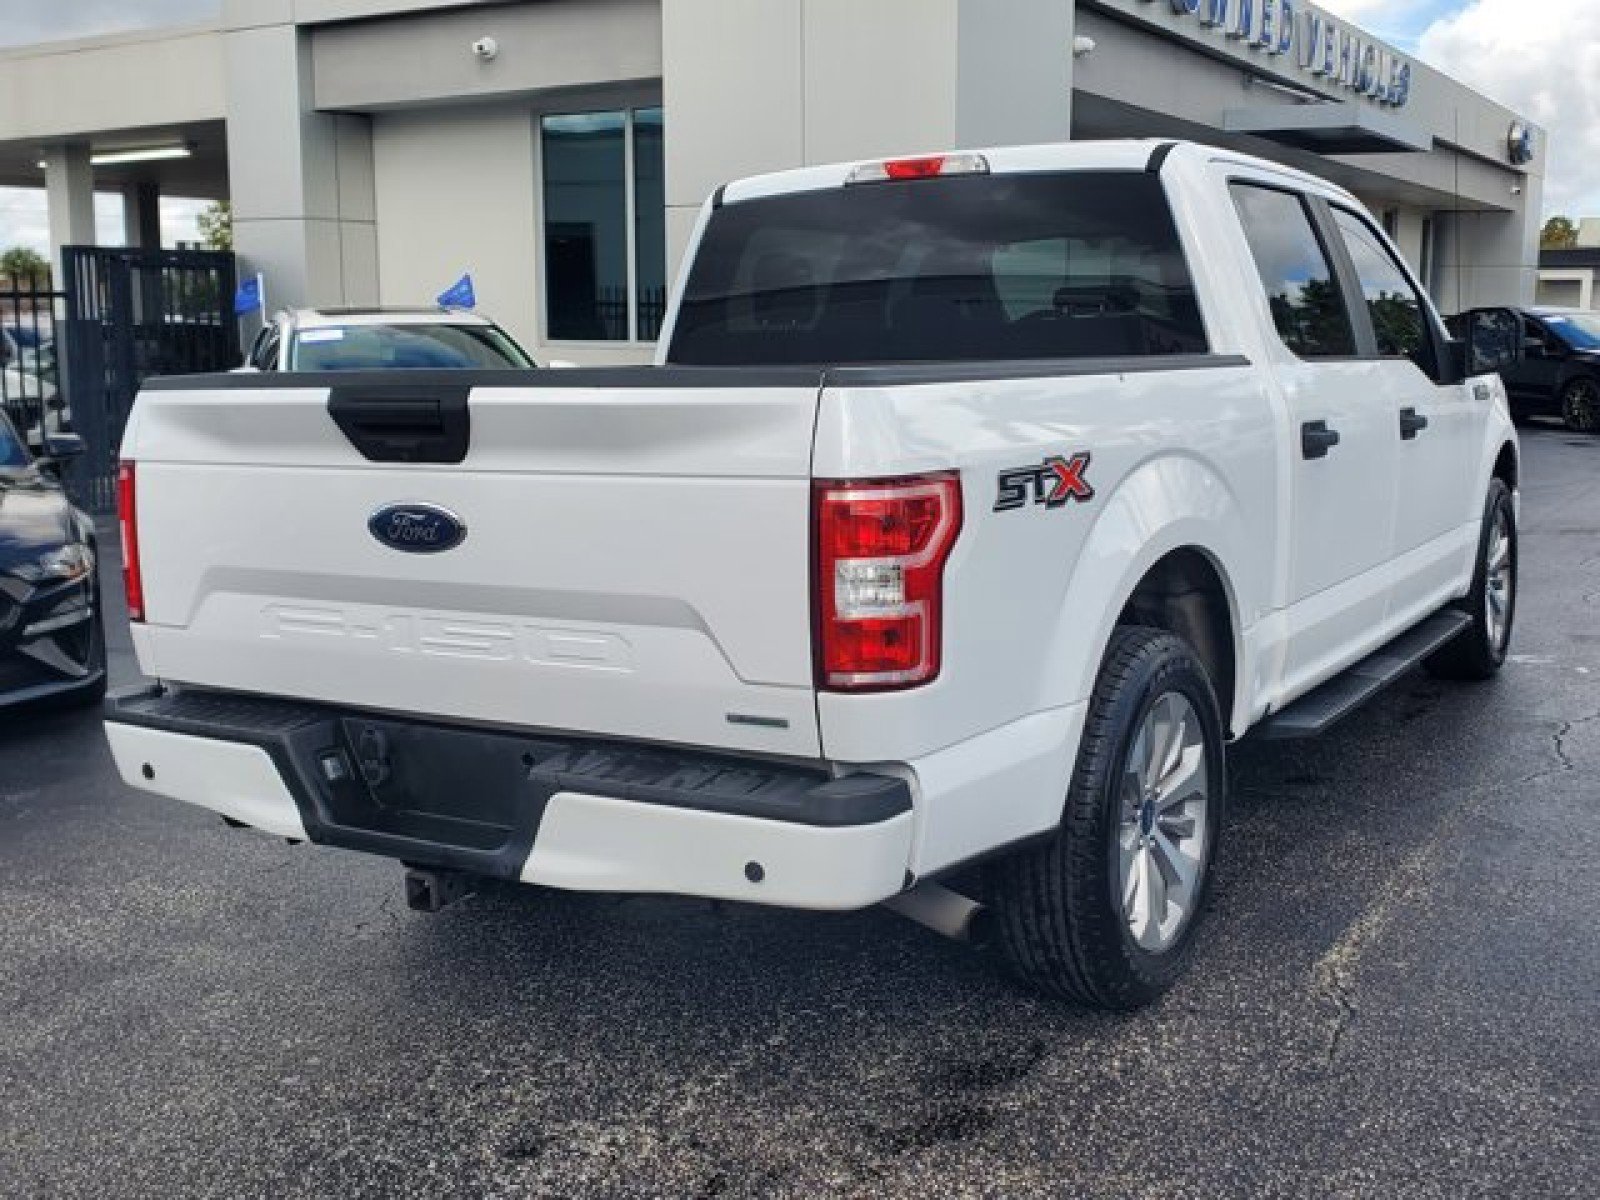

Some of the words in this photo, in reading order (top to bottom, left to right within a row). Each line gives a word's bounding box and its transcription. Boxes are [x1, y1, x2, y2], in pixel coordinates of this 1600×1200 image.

[993, 451, 1094, 511] STX
[387, 511, 441, 542] Ford
[259, 602, 638, 674] F-150
